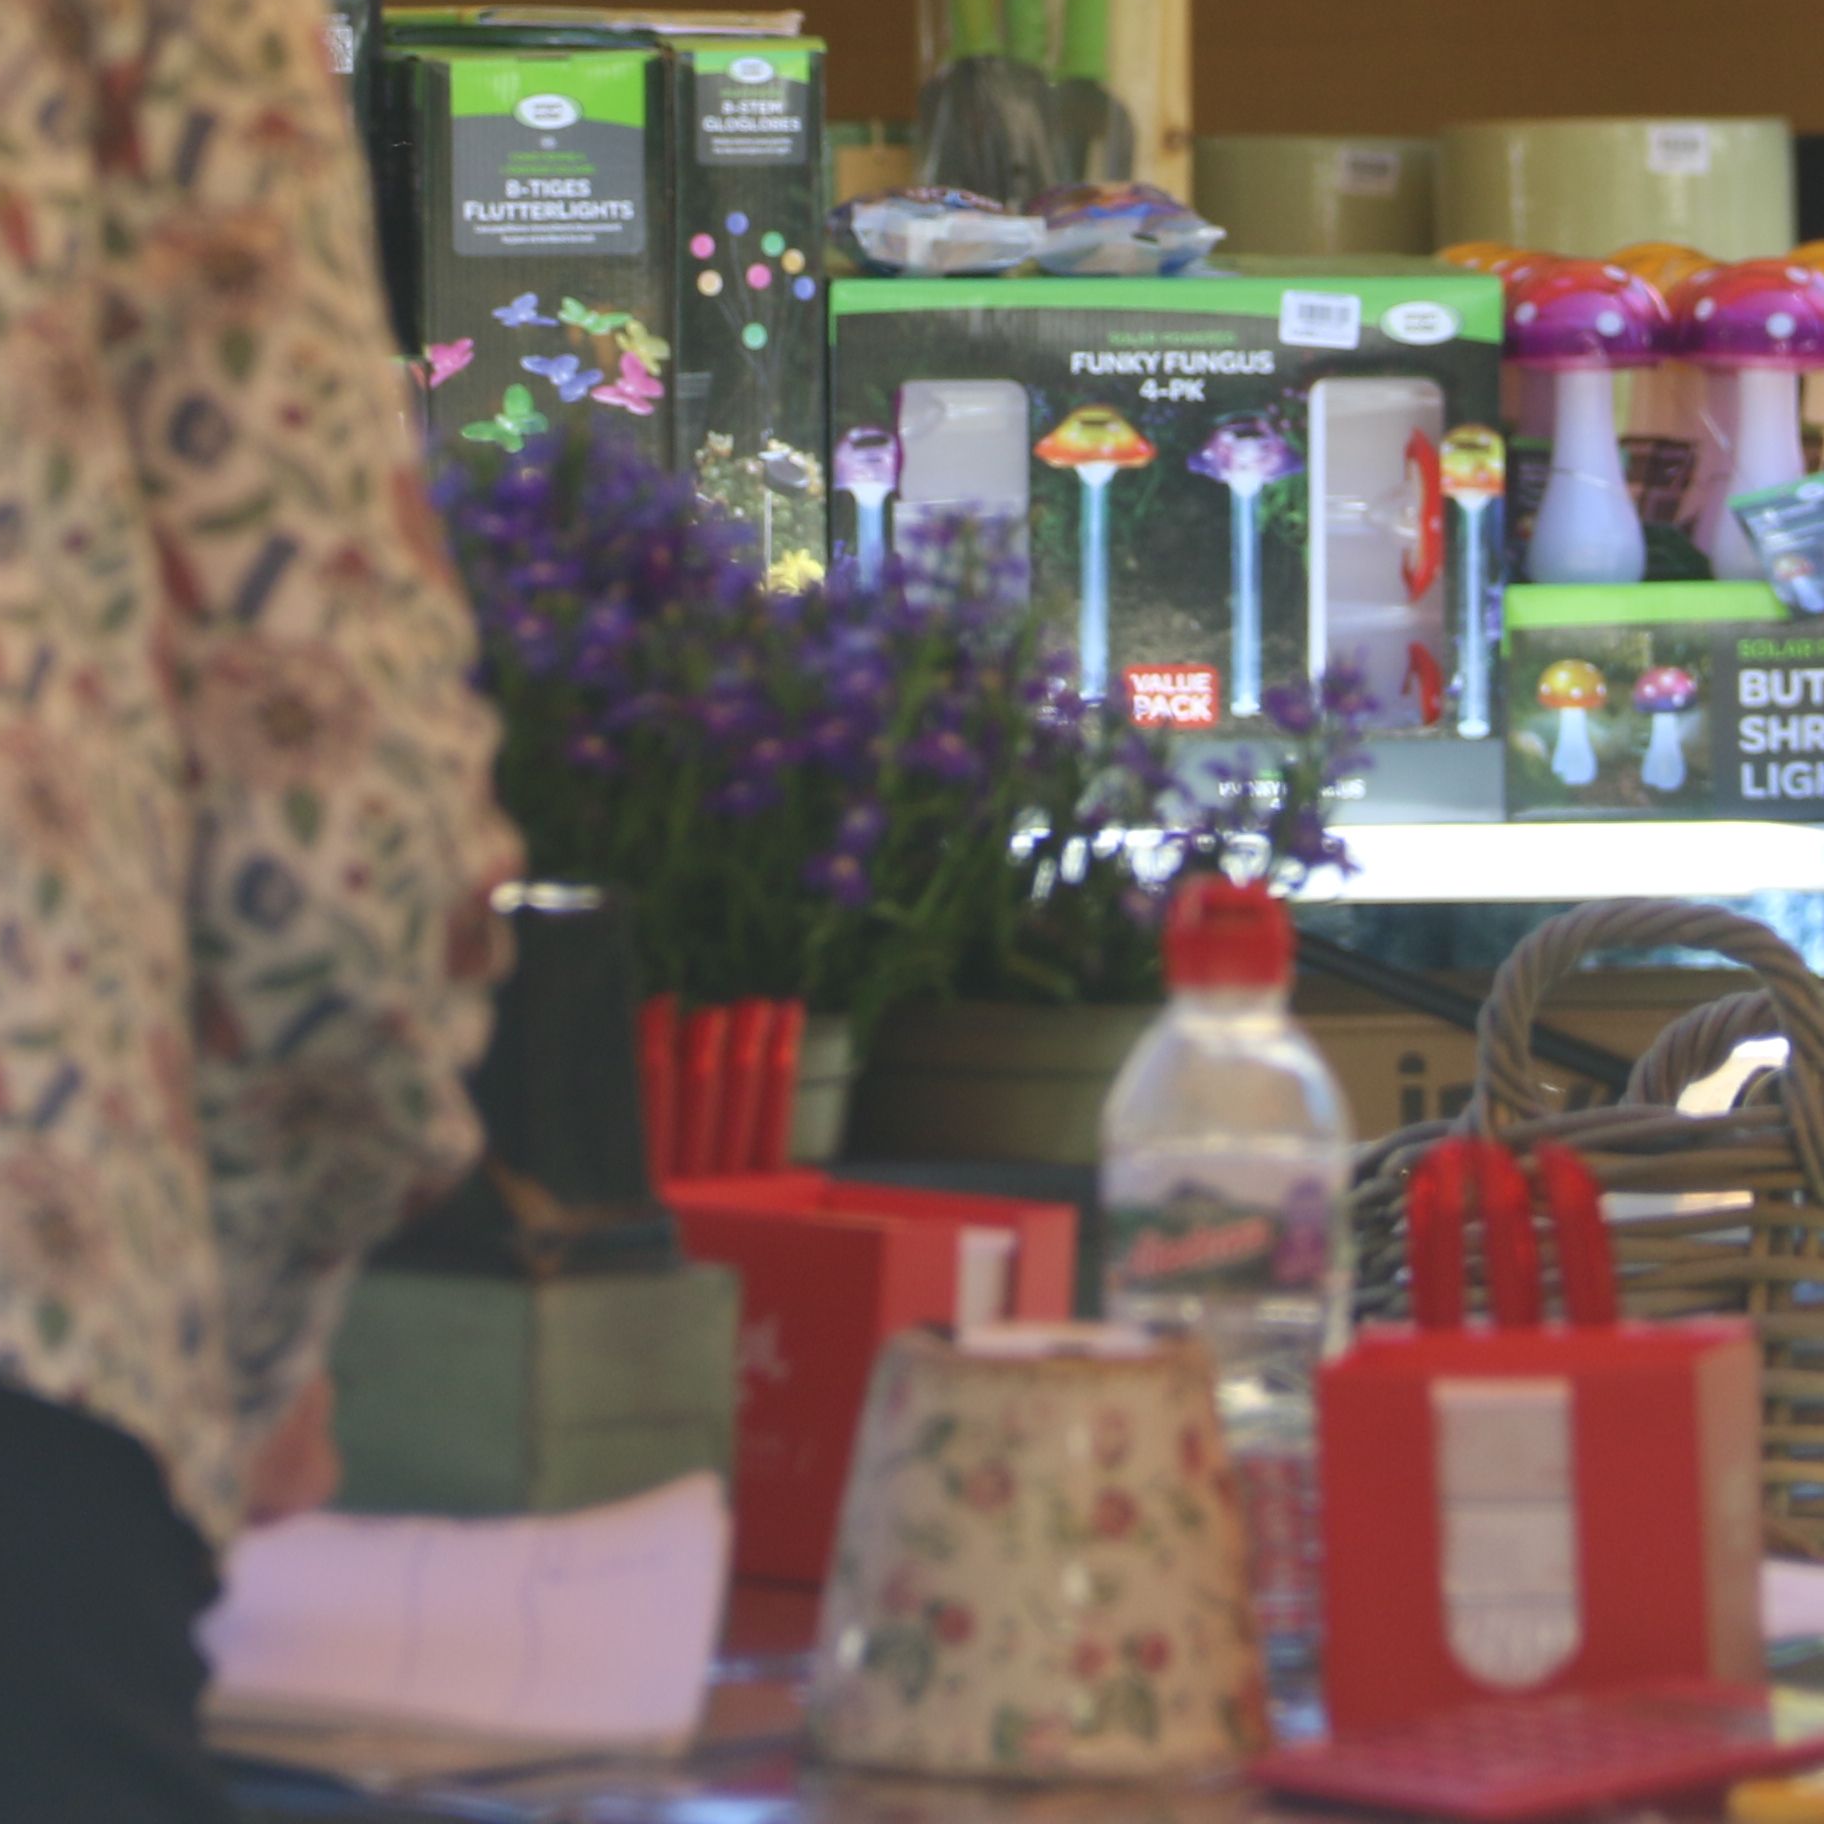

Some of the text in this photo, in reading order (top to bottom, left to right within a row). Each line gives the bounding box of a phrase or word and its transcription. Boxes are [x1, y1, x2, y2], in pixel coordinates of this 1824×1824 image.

[505, 178, 592, 199] 8-TIGES
[462, 199, 635, 222] FLUTTERLIGHTS
[1070, 351, 1274, 375] FUNKY FUNGUS
[1138, 378, 1206, 402] 4-PK
[1737, 638, 1813, 660] SOLAR
[1129, 673, 1212, 693] VALUE
[1134, 695, 1213, 722] PACK
